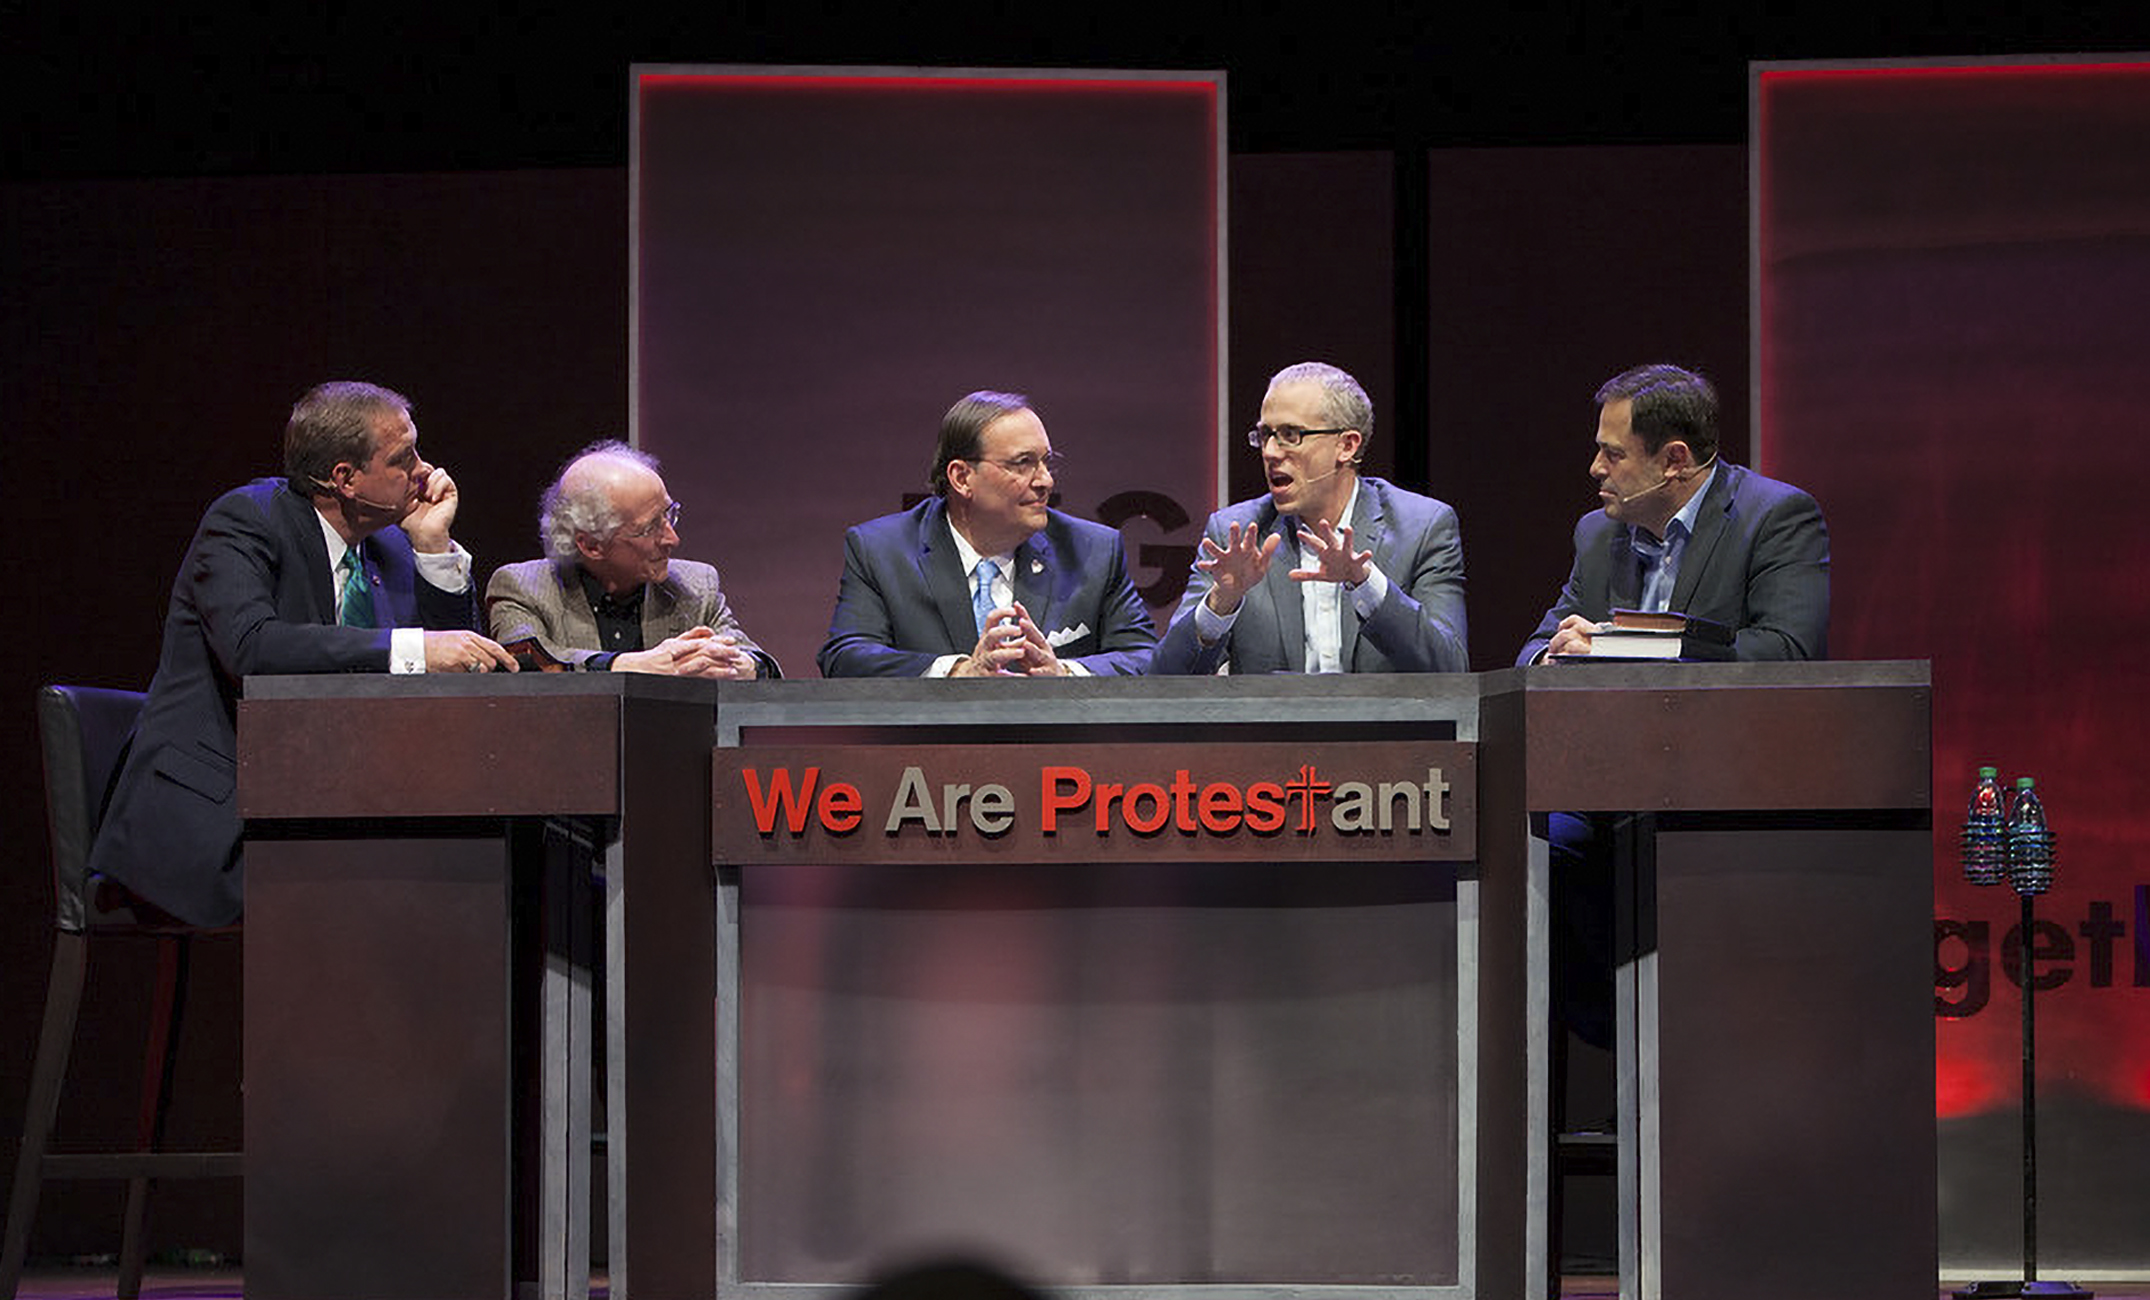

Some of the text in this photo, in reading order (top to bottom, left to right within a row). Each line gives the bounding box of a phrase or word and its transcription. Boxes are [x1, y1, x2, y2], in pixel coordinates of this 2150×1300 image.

[741, 764, 1451, 836] We Are Protestant
[1933, 884, 2150, 1018] get
